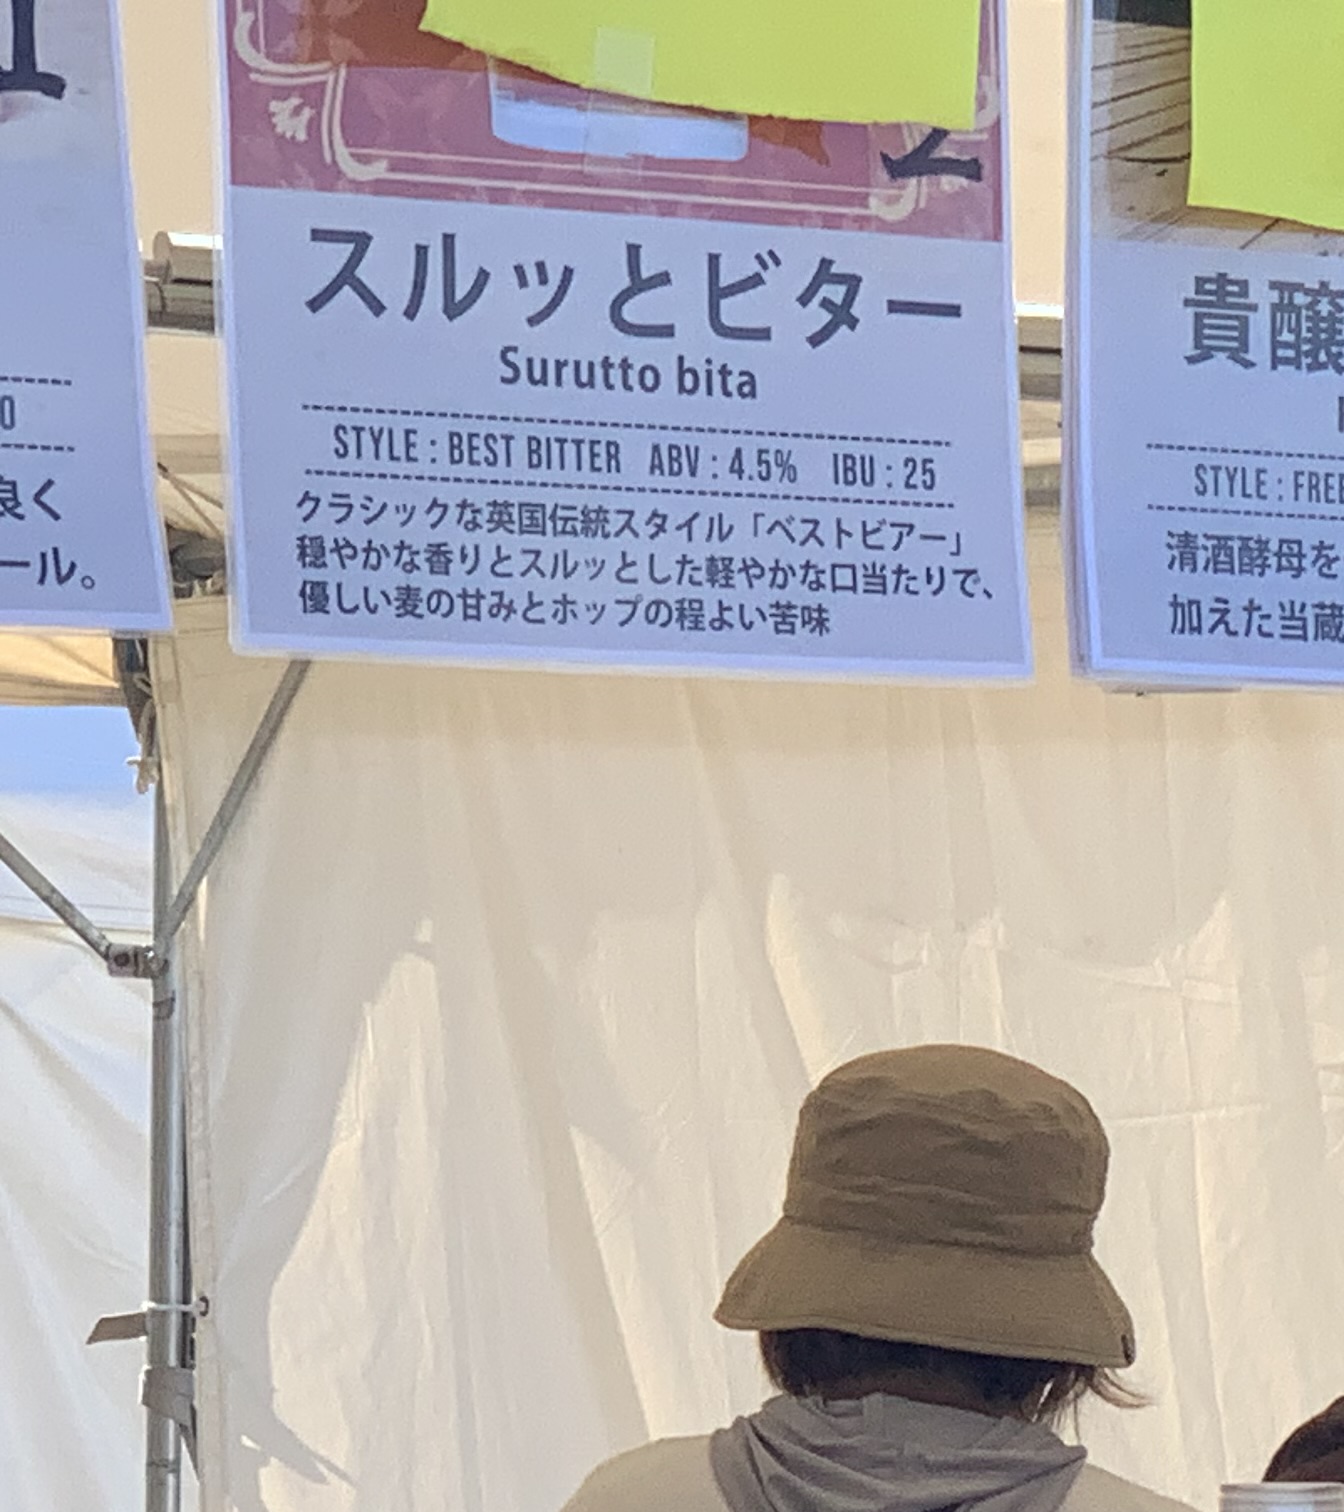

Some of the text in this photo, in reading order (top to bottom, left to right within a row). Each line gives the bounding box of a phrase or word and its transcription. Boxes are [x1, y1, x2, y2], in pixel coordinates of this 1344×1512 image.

[303, 226, 963, 350] スルッとビター
[499, 344, 758, 400] Surutto bita
[333, 424, 420, 464] STYLE
[448, 430, 517, 470] BEST
[526, 435, 621, 476] BITTER
[649, 443, 702, 480] ABV
[728, 447, 797, 484] 4.5%
[833, 453, 878, 487] IBU
[902, 455, 935, 491] 25
[1194, 464, 1268, 499] STYLE
[295, 489, 966, 556] クラシックな英国伝統スタイル「ベストビアー」
[295, 536, 994, 599] 穏やかな香りとスルッとした軽やかな口当たりで、
[299, 581, 832, 638] 優しい麦の甘みとホップの程よい苦味
